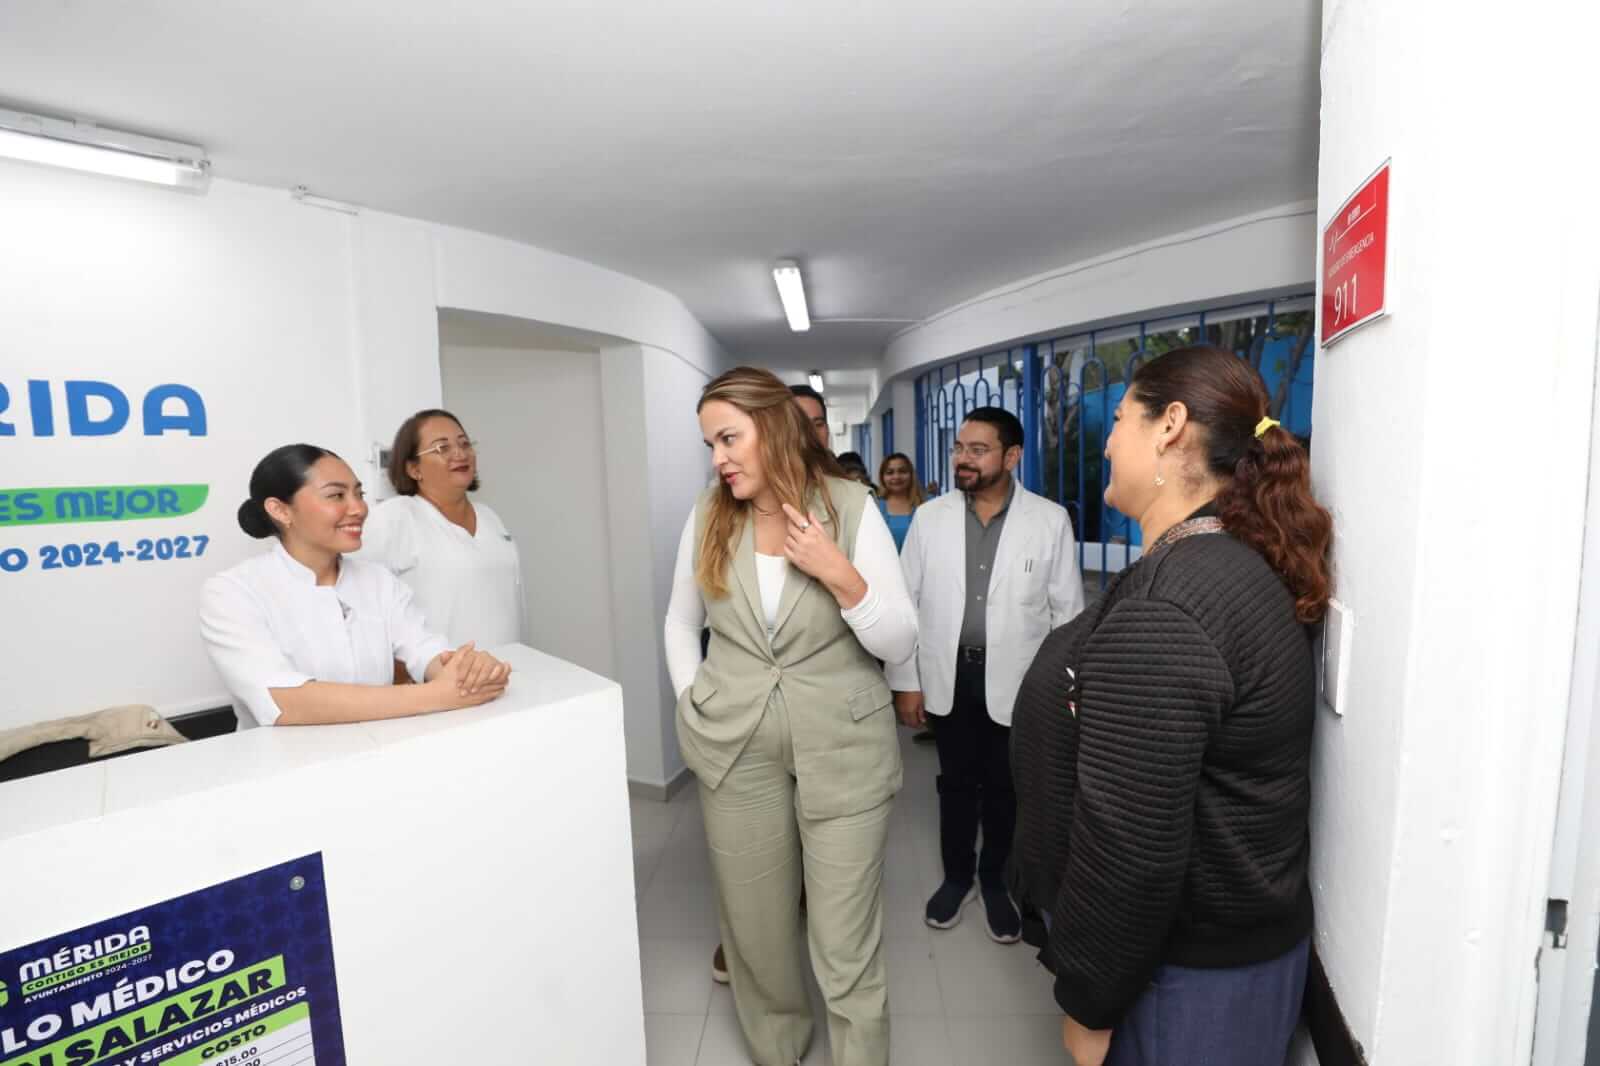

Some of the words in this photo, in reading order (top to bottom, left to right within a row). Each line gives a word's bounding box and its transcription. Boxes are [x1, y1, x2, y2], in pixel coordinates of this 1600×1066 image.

[1334, 272, 1358, 327] 911
[55, 487, 182, 521] MEJOR
[39, 534, 210, 570] 2024-2027
[19, 925, 151, 983] MÉRIDA
[23, 971, 104, 1004] AYUNTAMIENTO
[105, 953, 153, 976] 2024-2027
[26, 966, 86, 992] CONTIGO
[89, 958, 105, 971] ES
[108, 944, 148, 963] MEJOR
[70, 949, 236, 1028] MÉDICO
[64, 968, 273, 1066] SALAZAR
[141, 1016, 234, 1064] SERVICIOS
[235, 985, 308, 1025] MÉDICOS
[201, 1024, 267, 1060] COSTO
